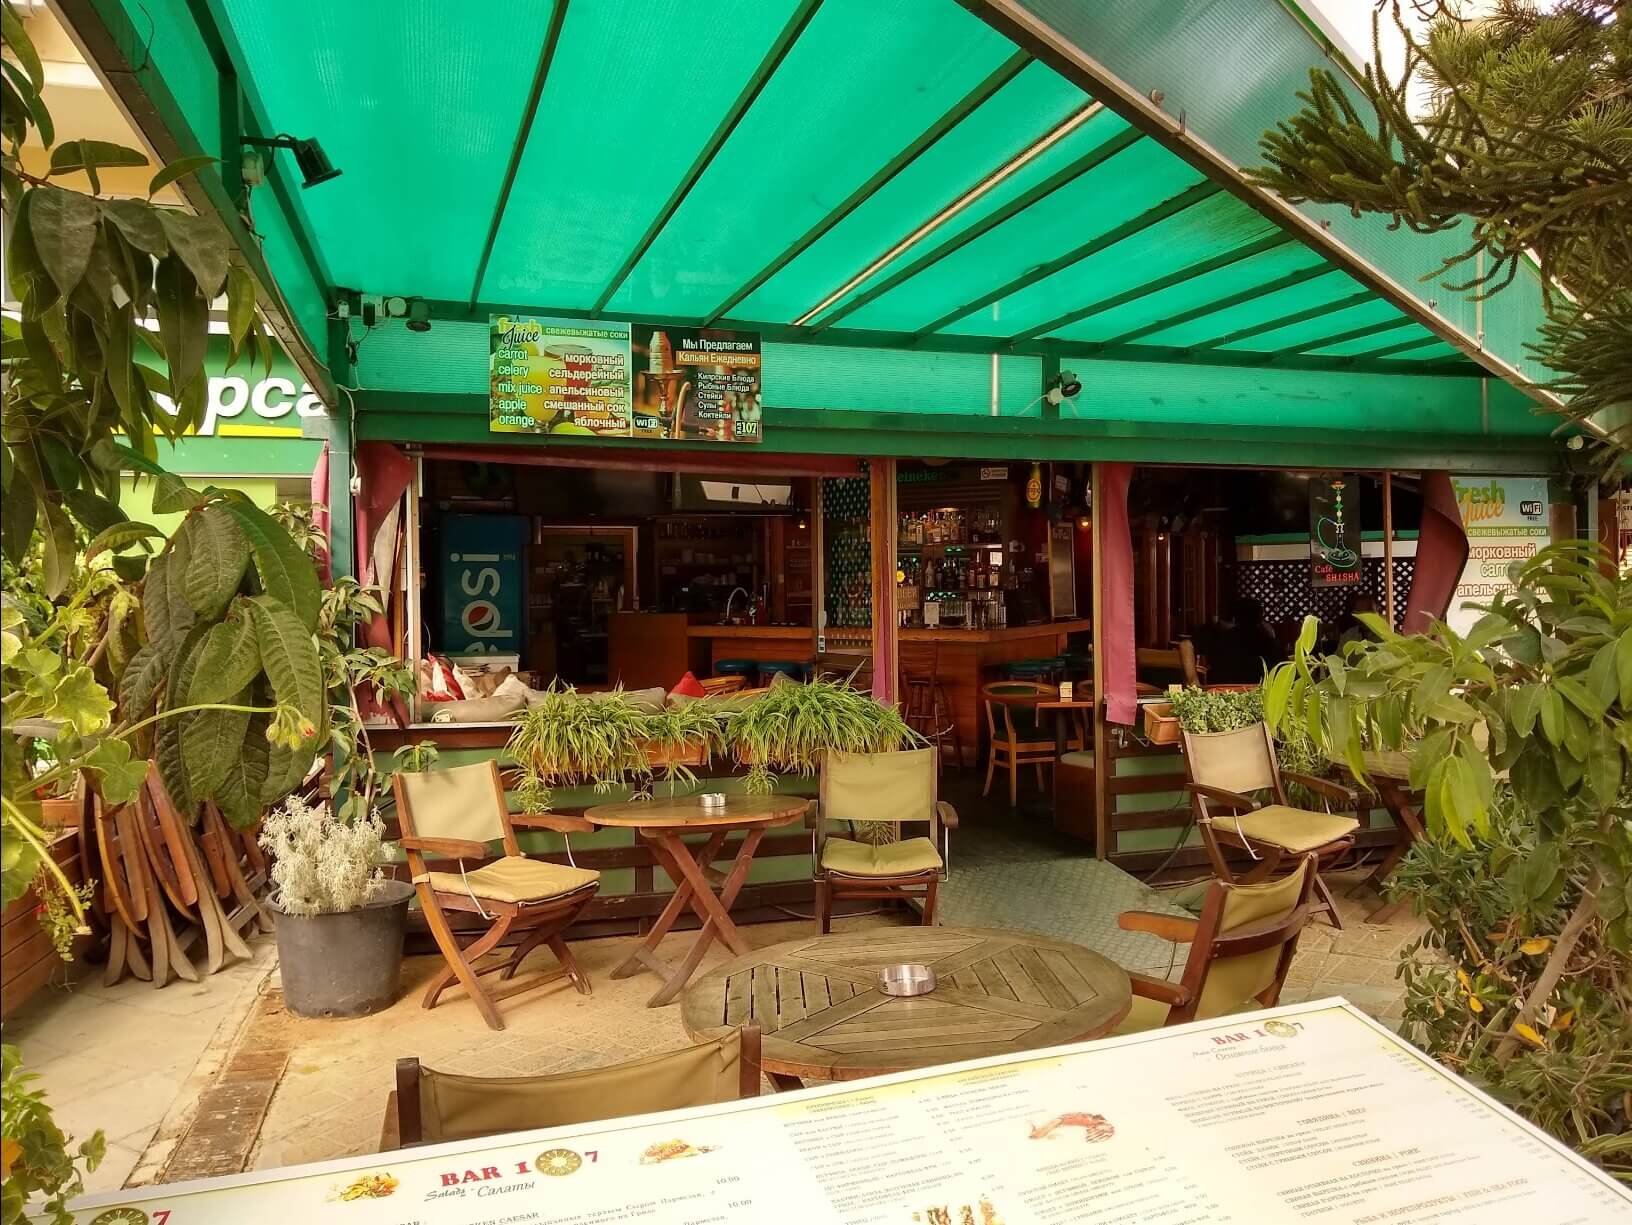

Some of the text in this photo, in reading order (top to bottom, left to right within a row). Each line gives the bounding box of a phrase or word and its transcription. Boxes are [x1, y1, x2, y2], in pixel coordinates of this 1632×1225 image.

[502, 324, 540, 350] Juice
[545, 327, 608, 338] свежевыжатые
[682, 339, 753, 352] Мы Предлагаем
[498, 349, 528, 360] carrot
[565, 353, 624, 366] морковный
[679, 352, 756, 365] Кальян Ежедневно
[498, 365, 529, 378] celery
[549, 368, 624, 381] сельдерейный
[697, 372, 755, 384] Кипрские Блюда
[498, 382, 543, 395] mix juice
[549, 385, 624, 398] апельсиновый
[697, 382, 750, 393] Рыбные Блюда
[697, 391, 723, 401] Стейки
[498, 399, 527, 412] apple
[544, 400, 625, 413] смешанный сок
[697, 402, 717, 411] Супы
[499, 415, 535, 428] orange
[697, 411, 731, 420] Коктейли
[575, 416, 626, 429] яблочный
[742, 422, 757, 434] 107
[1467, 527, 1547, 537] свежевыжатые соки
[1326, 573, 1360, 582] SHISHA
[1210, 1032, 1252, 1045] BAR
[440, 1166, 502, 1187] BAR
[424, 1181, 536, 1202] Salads Салаты
